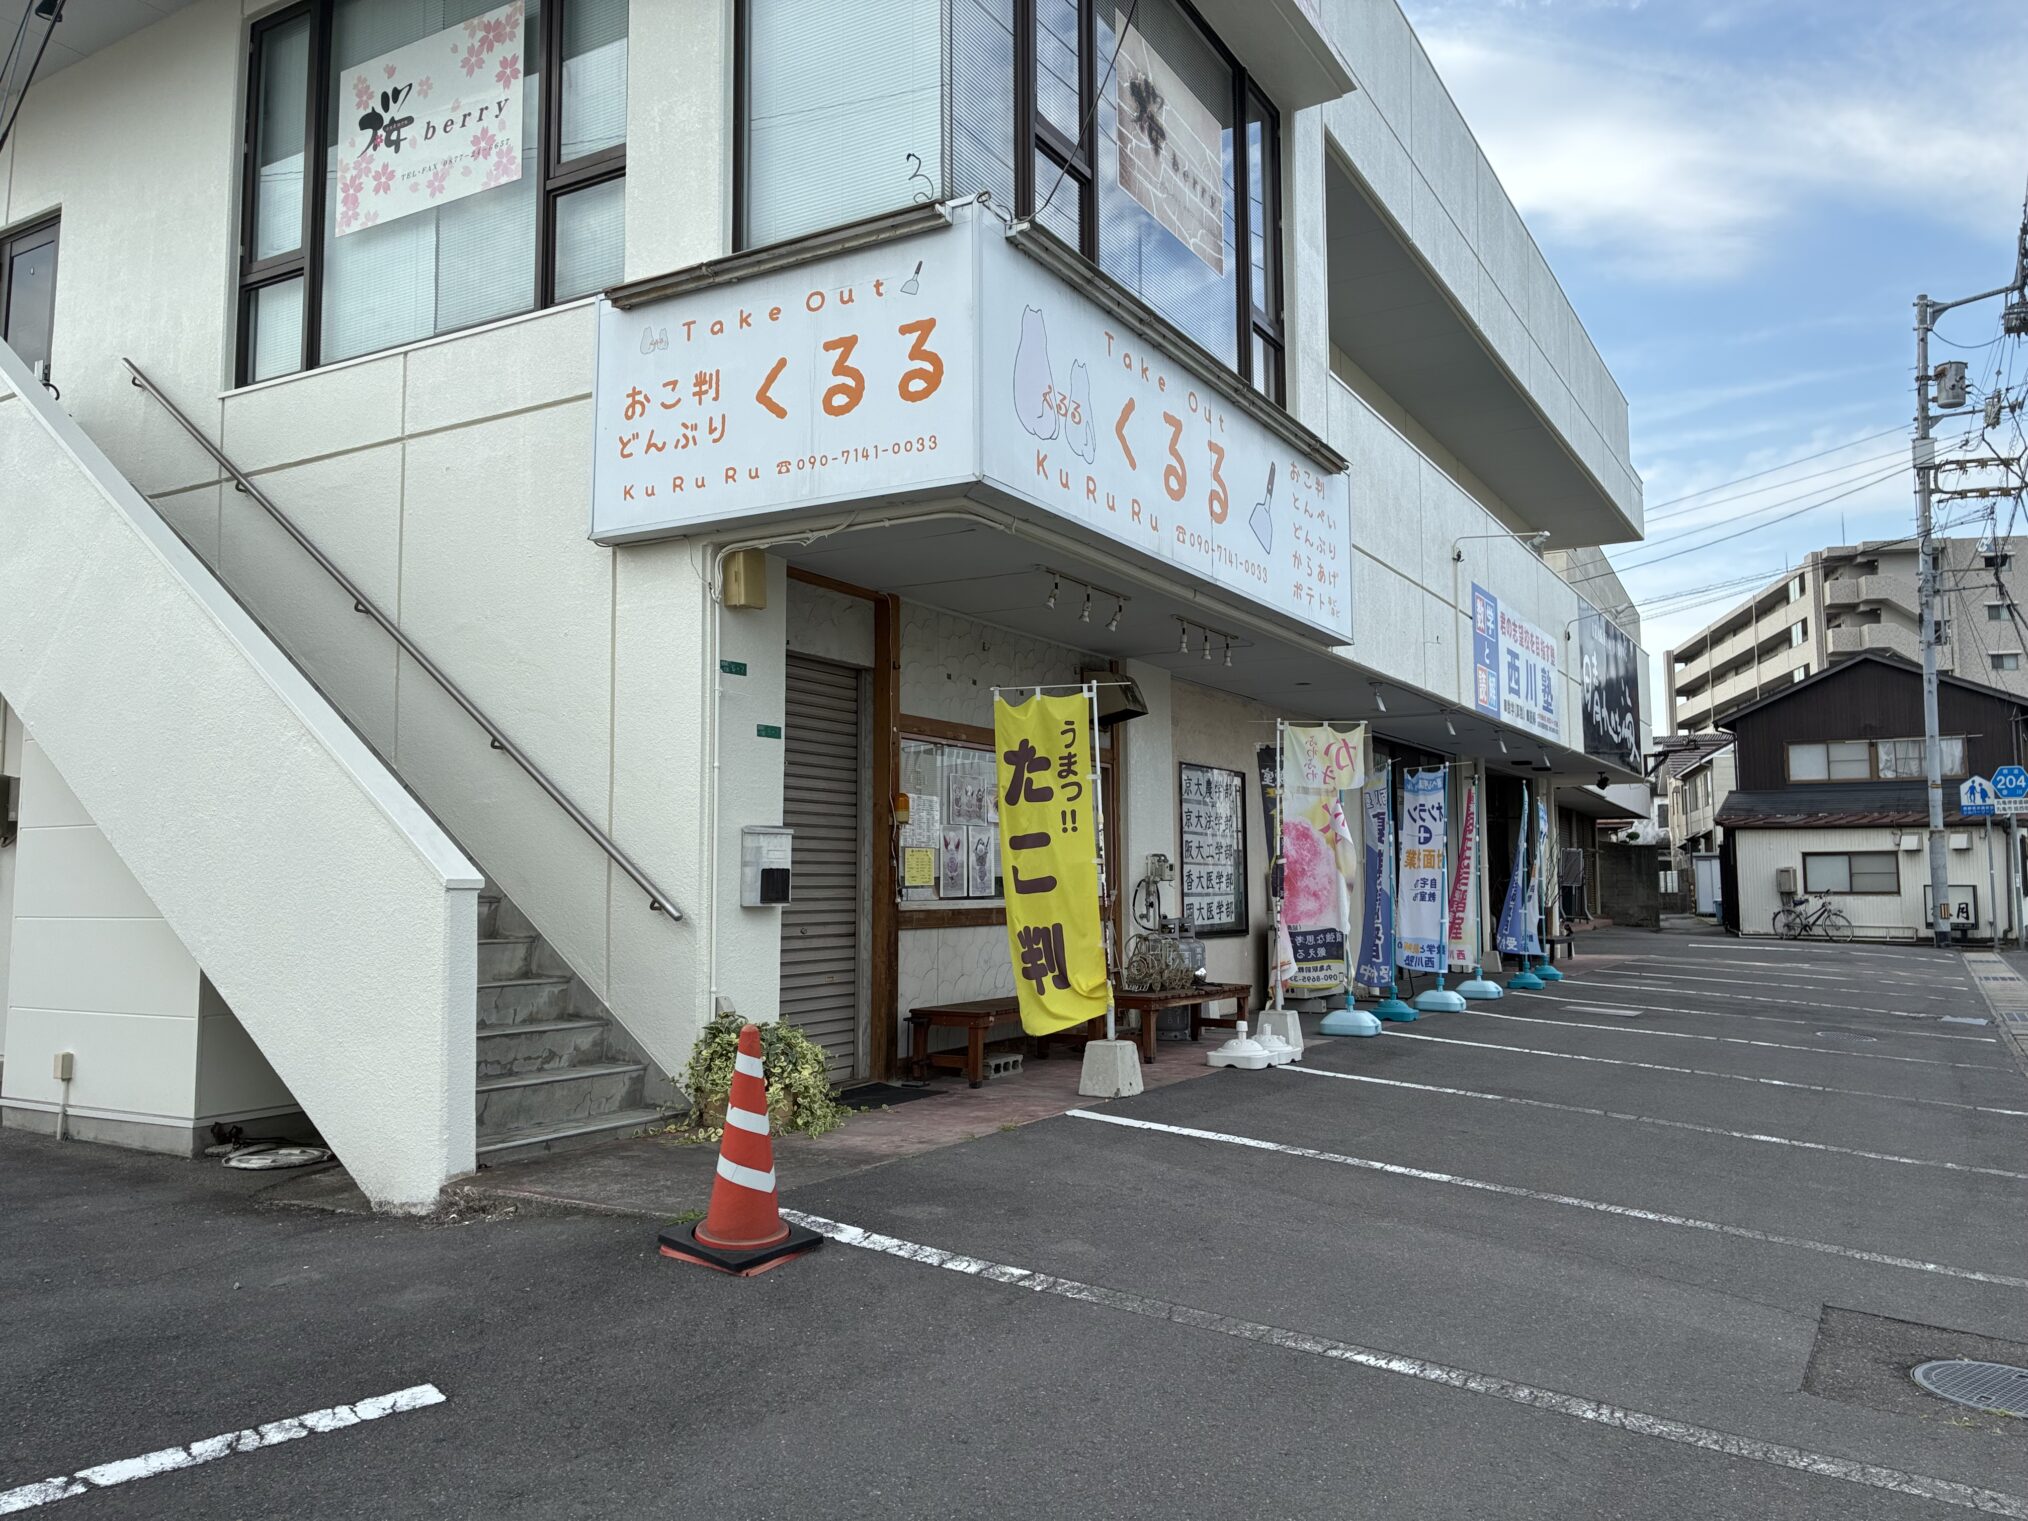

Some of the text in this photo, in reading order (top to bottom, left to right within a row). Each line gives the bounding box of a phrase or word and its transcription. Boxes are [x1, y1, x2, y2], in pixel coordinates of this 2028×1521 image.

[424, 98, 509, 141] berry
[682, 279, 884, 342] Take Out
[755, 318, 944, 420] くるる
[1104, 331, 1225, 434] Take Out
[624, 369, 721, 421] おこ判
[1042, 384, 1083, 426] くるる
[619, 414, 727, 459] どんぶり
[796, 435, 938, 471] 090-7141-0033
[1115, 397, 1229, 525] くるる
[1290, 460, 1325, 500] おこ判
[1189, 532, 1269, 584] 090-7141-0033
[1293, 521, 1336, 560] どんぶり
[1292, 550, 1339, 588] からあげ
[1293, 581, 1326, 611] ポテト
[1506, 647, 1554, 715] 西川塾
[1996, 775, 2027, 789] 204
[1184, 808, 1233, 833] 京大法学部
[1003, 738, 1071, 996] たこ判
[1184, 840, 1233, 862] 阪大工学部
[1185, 870, 1233, 892] 香大医学部
